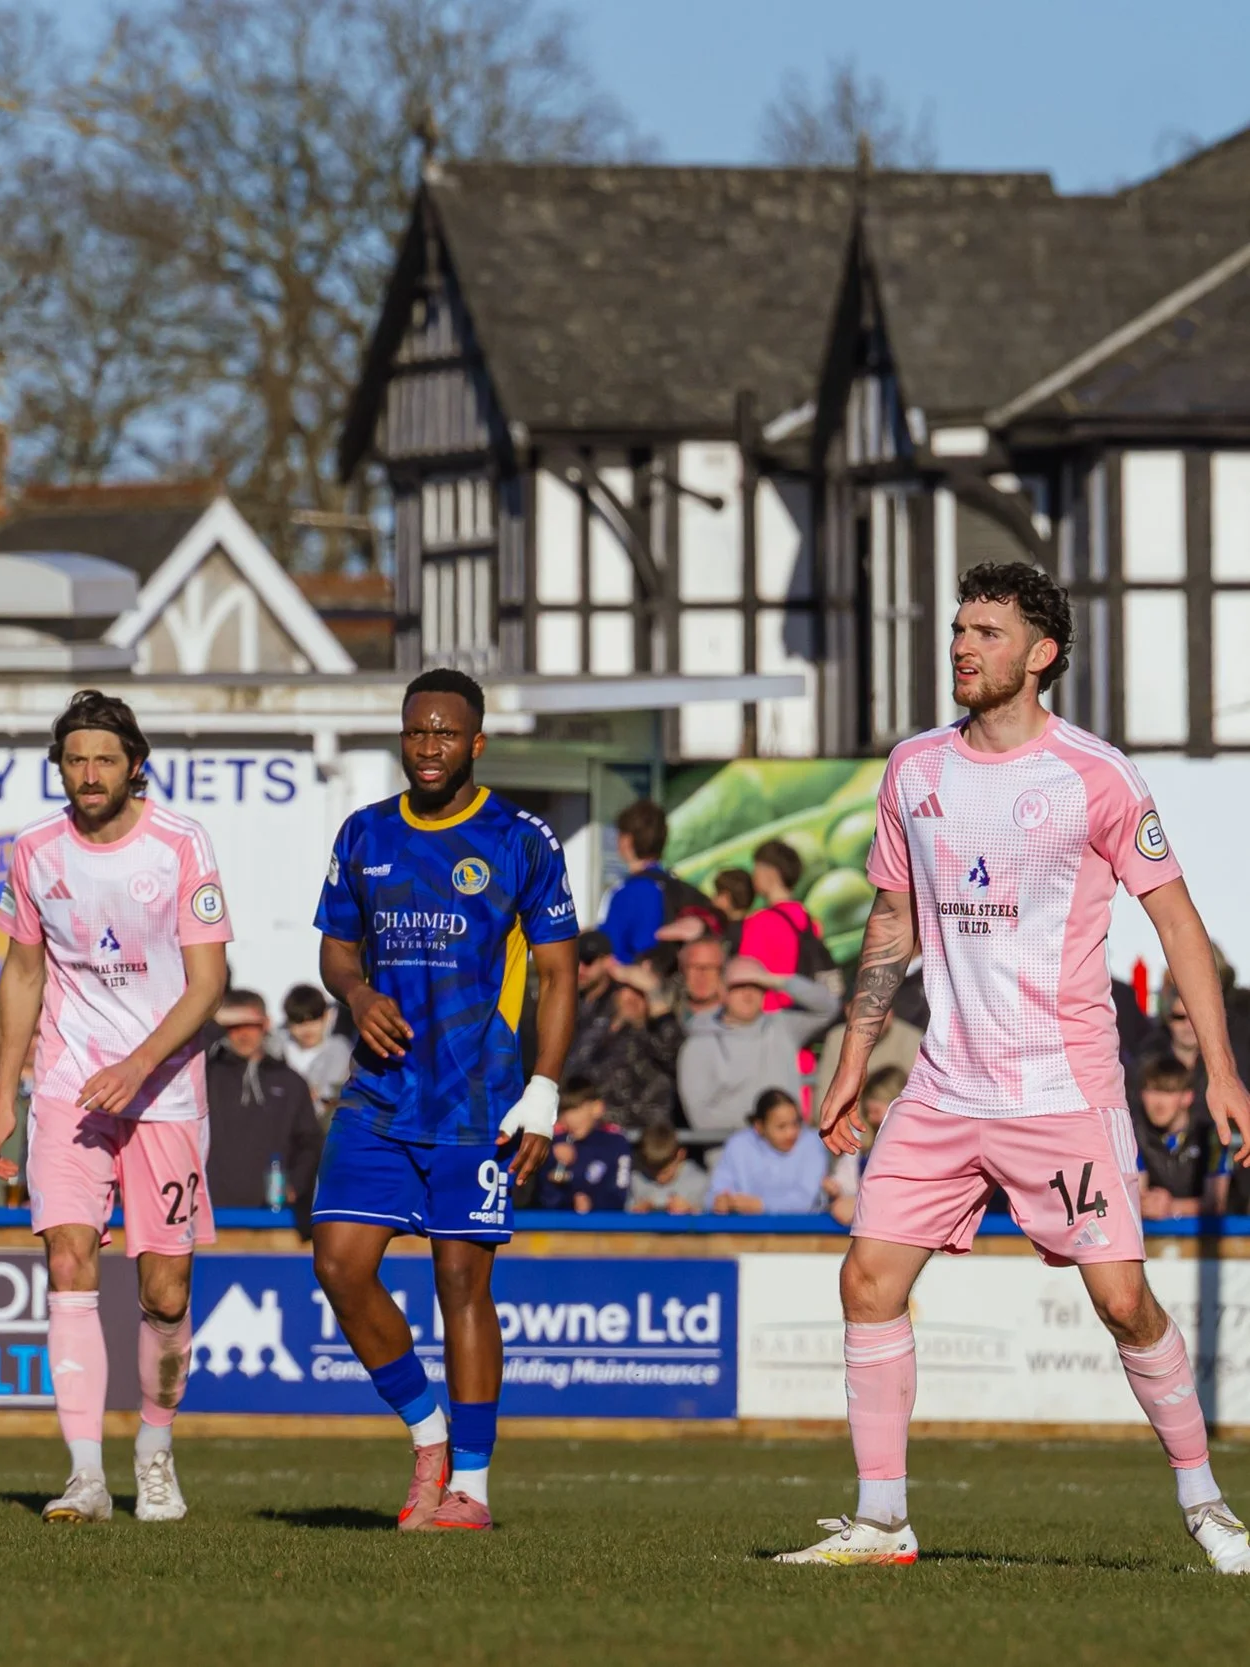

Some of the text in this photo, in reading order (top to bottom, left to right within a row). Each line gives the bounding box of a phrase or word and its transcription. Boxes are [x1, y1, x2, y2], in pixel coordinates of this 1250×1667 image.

[43, 758, 297, 803] LNETS
[1147, 826, 1163, 846] B
[203, 896, 217, 912] B
[978, 904, 1019, 918] STEELS
[373, 911, 468, 936] CHARMED
[958, 921, 992, 934] UK LTD.
[386, 937, 447, 951] INTERORS
[478, 1159, 499, 1210] 9
[1049, 1161, 1108, 1226] 14
[434, 1292, 631, 1343] owne
[637, 1292, 721, 1344] Ltd
[502, 1357, 572, 1390] uilding
